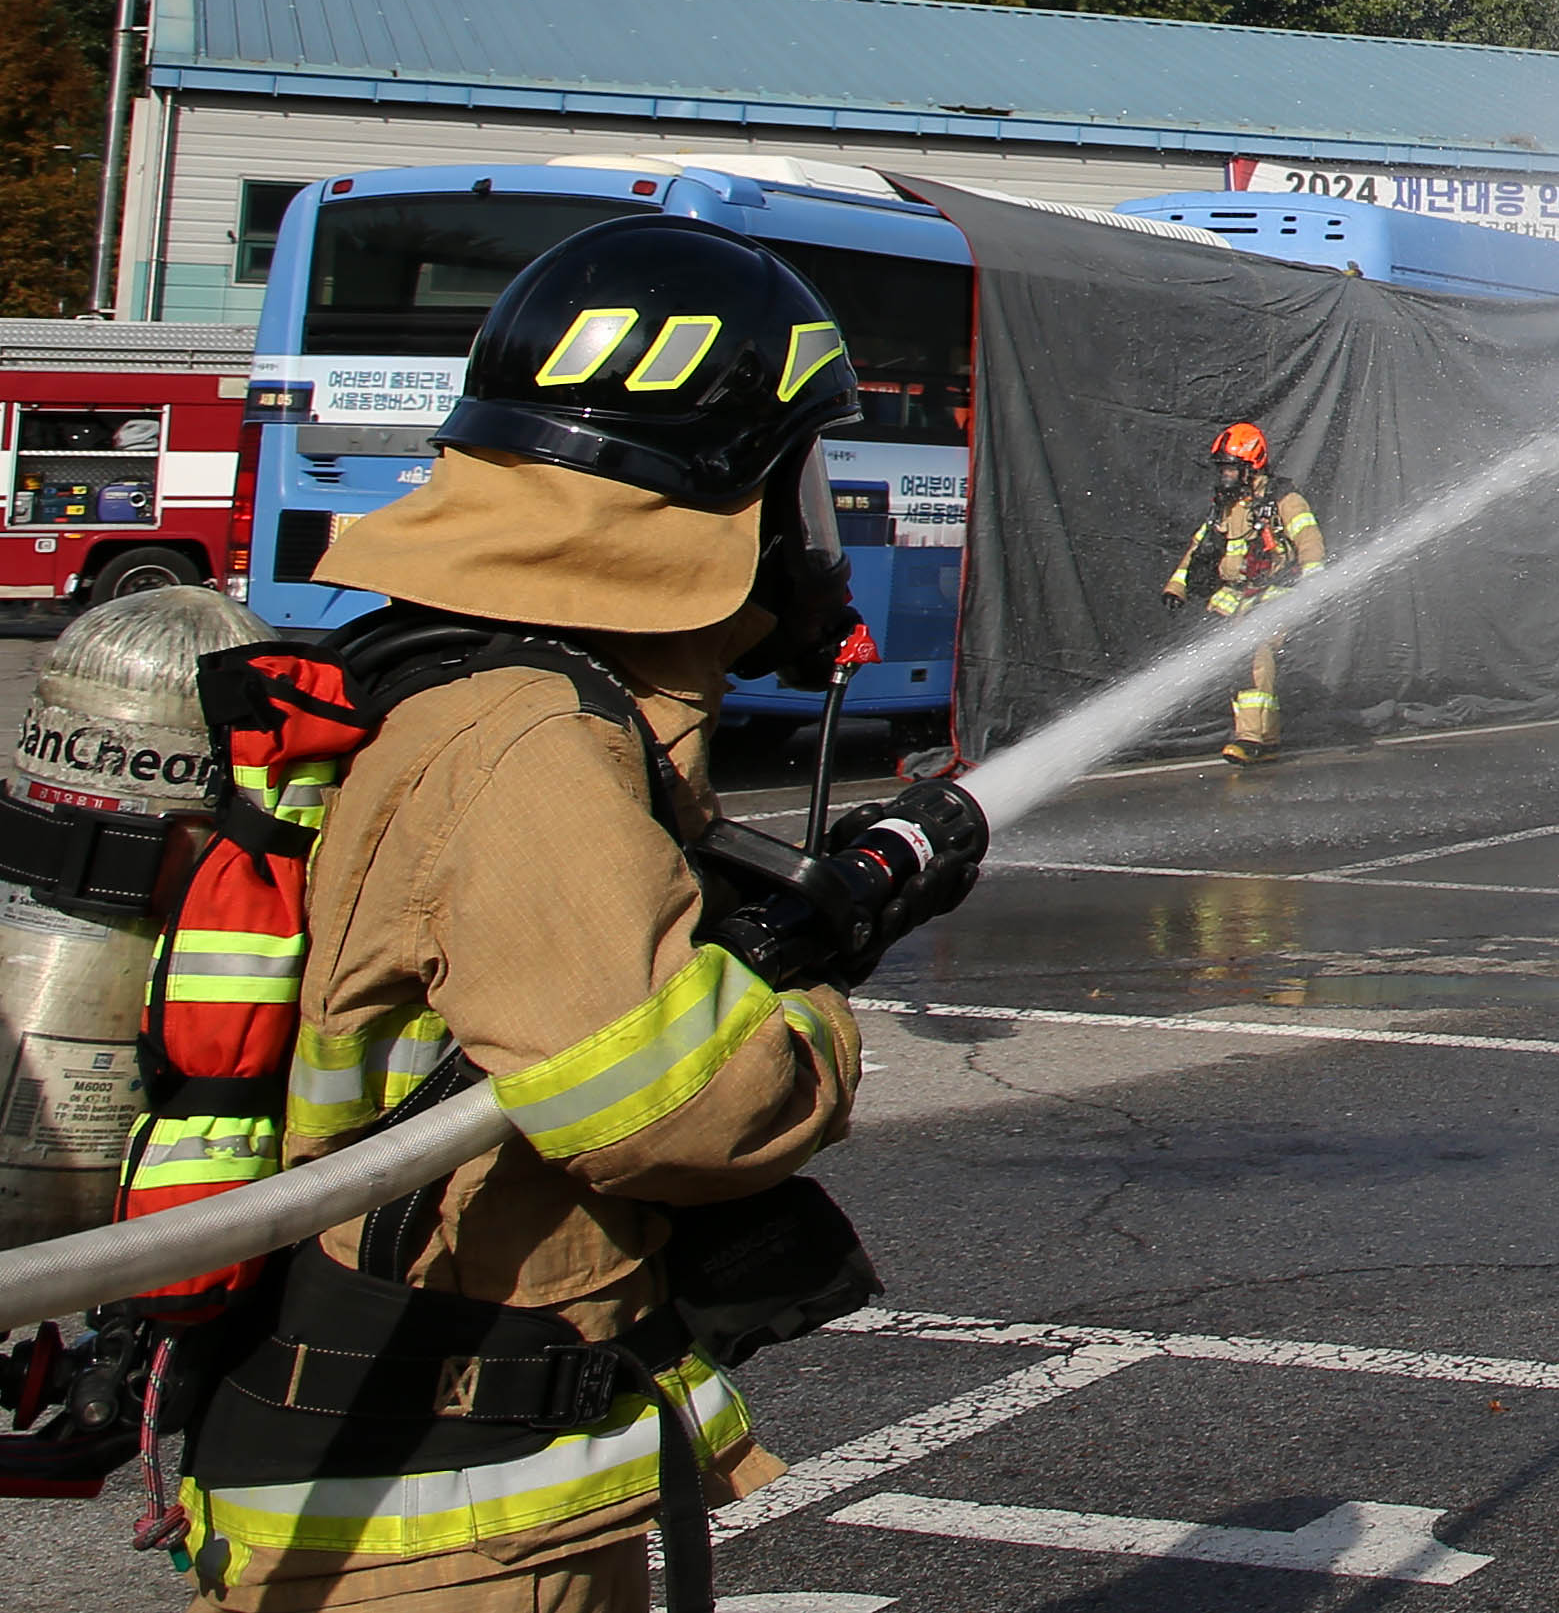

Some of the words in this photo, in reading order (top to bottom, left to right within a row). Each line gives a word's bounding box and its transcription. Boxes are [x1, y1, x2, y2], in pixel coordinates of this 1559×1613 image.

[1286, 172, 1378, 204] 2024
[1392, 176, 1525, 217] 재난대응
[328, 370, 388, 388] 여러분의
[389, 371, 454, 390] 출퇴근길,
[328, 393, 432, 412] 서울동행버스가
